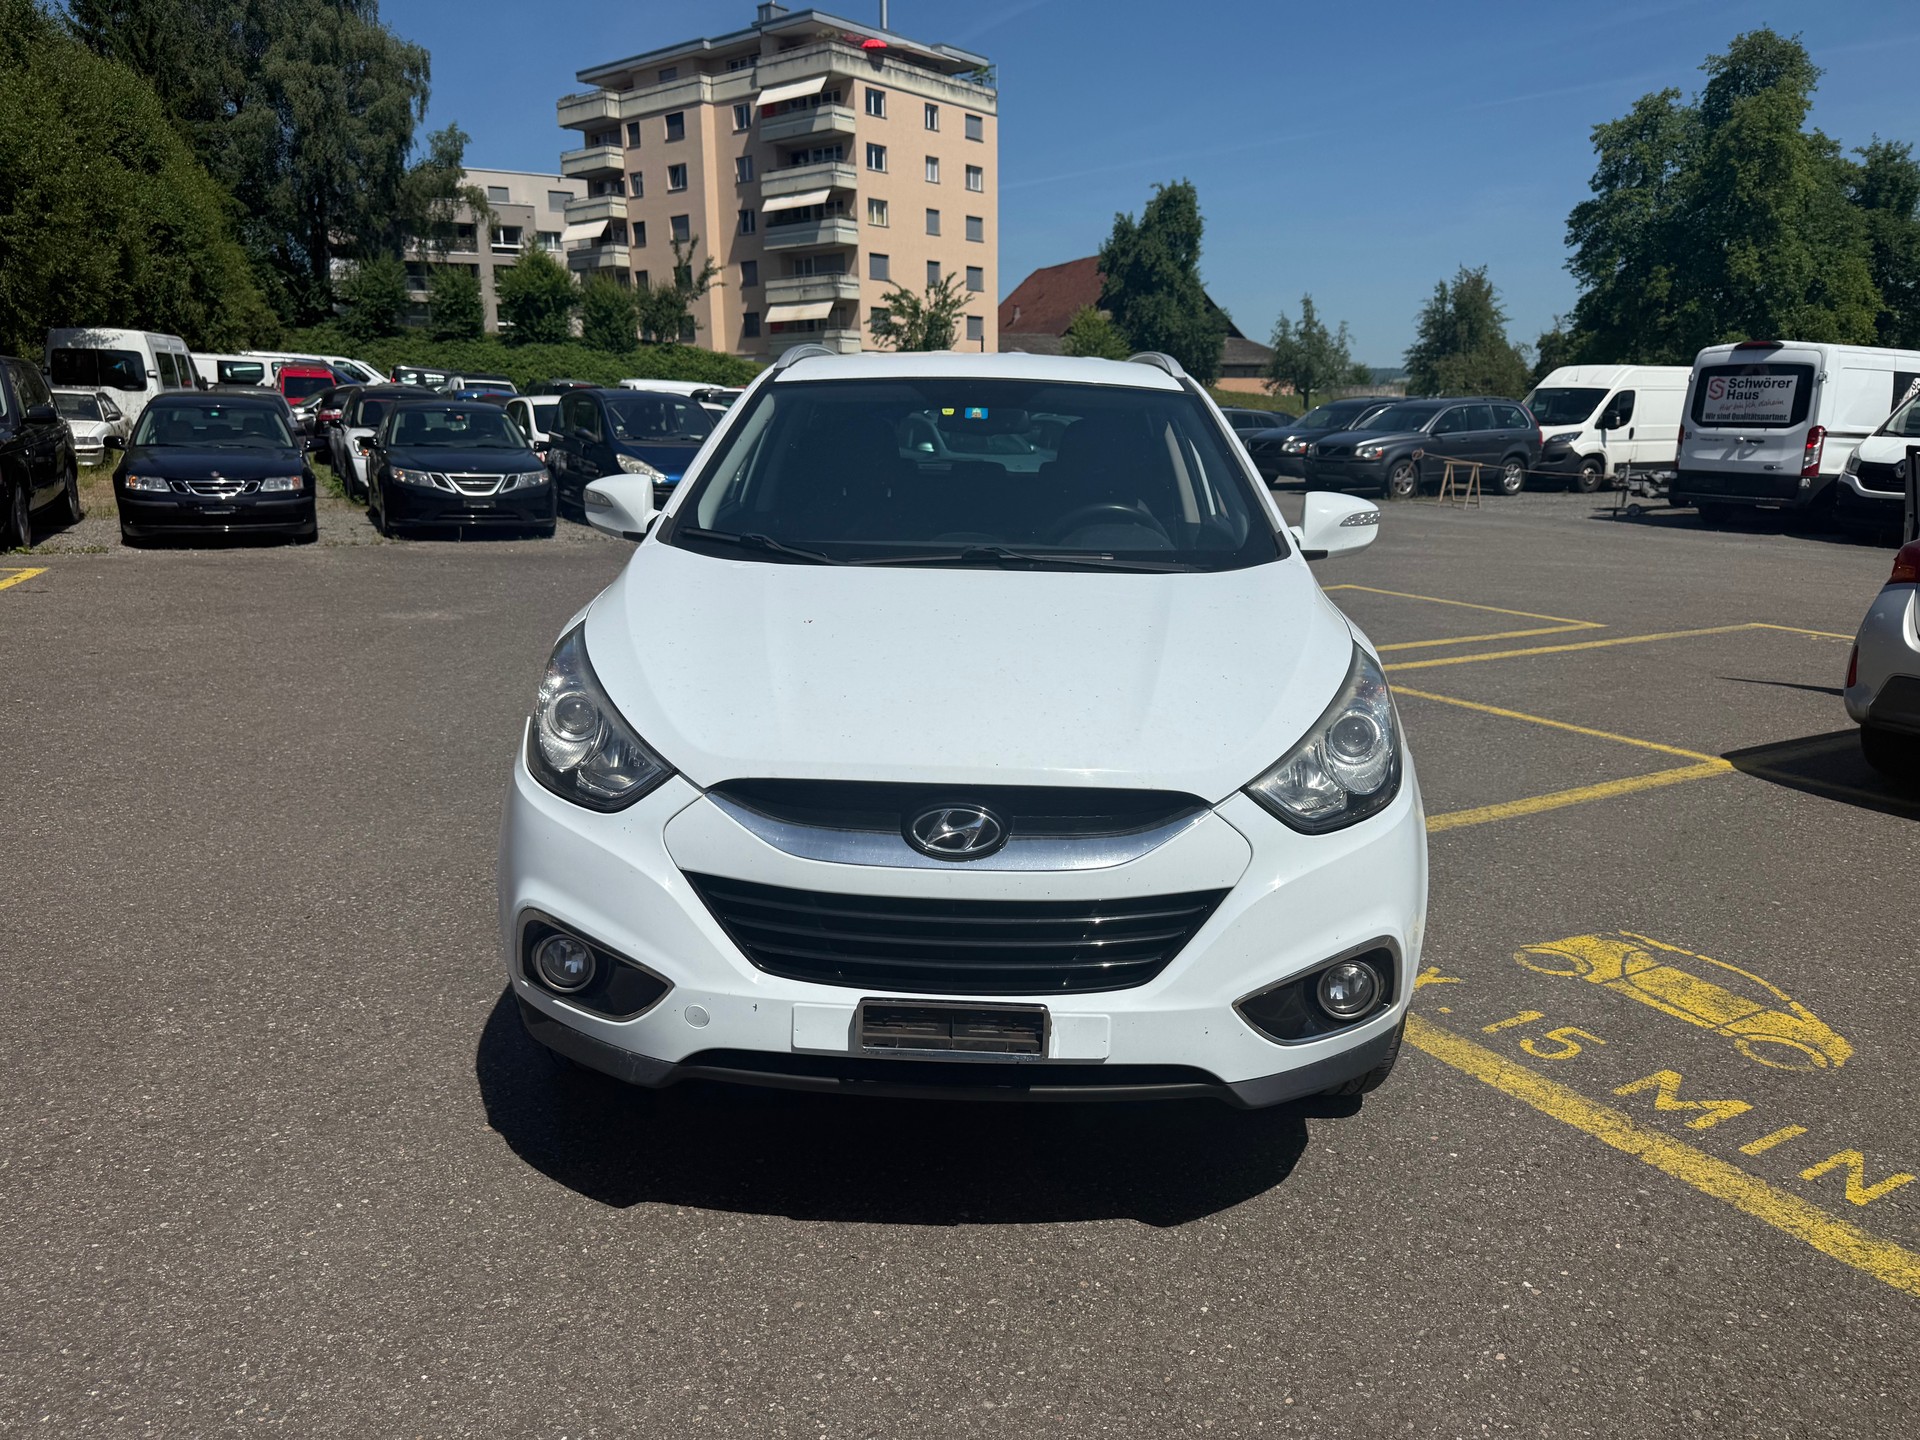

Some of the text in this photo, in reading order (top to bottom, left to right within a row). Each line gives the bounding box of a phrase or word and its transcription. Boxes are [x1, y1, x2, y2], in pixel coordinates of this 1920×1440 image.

[1728, 377, 1792, 388] Schwörer
[1726, 389, 1760, 400] Haus
[1705, 412, 1717, 421] Wir
[1717, 412, 1731, 421] sind
[1482, 1010, 1606, 1060] 15
[1612, 1069, 1915, 1206] MIN
